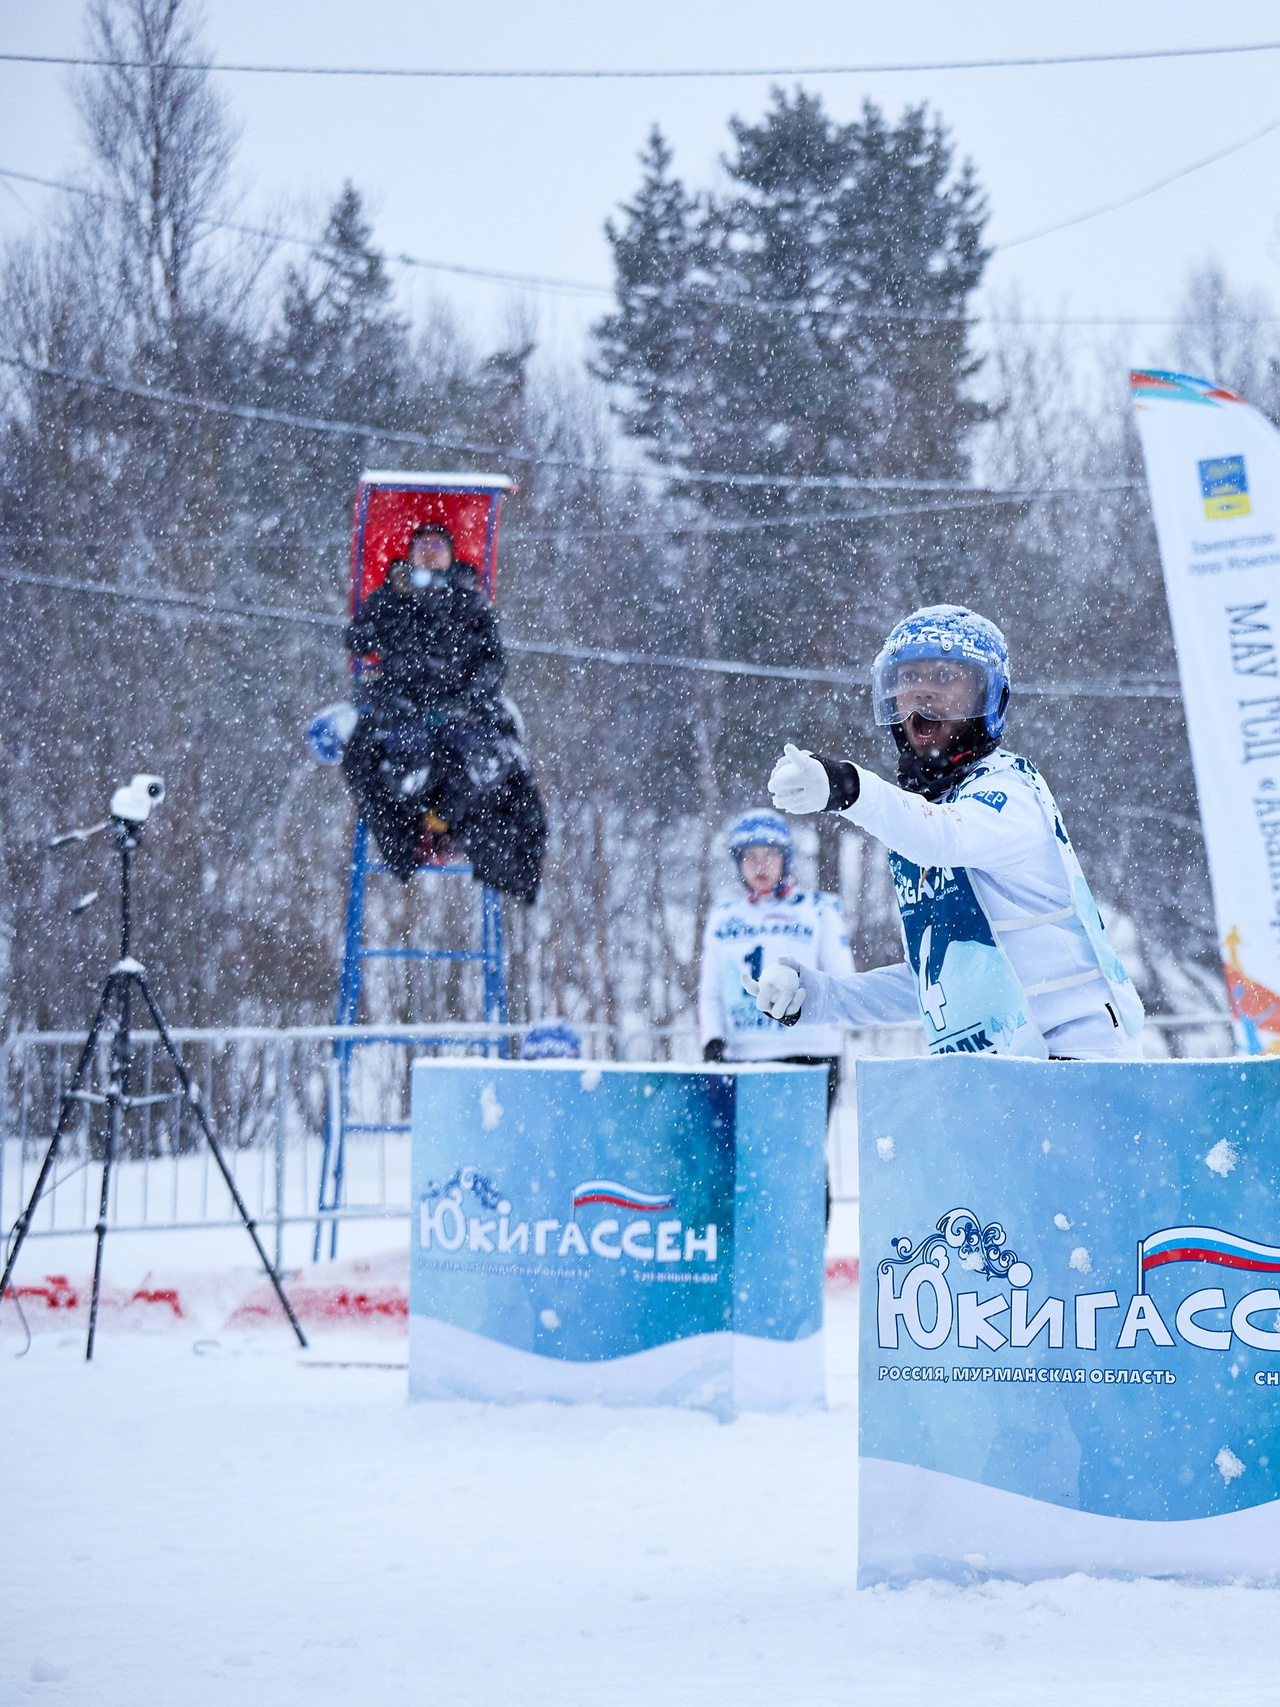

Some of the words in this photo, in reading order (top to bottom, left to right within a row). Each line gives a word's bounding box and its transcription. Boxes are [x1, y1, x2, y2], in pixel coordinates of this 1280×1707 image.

[1225, 600, 1280, 679] МАУ
[918, 924, 947, 1031] 4
[878, 1366, 949, 1383] РОССИЯ,
[952, 1367, 1086, 1384] МУРМАНСКАЯ
[1089, 1369, 1177, 1384] ОБЛАСТЬ
